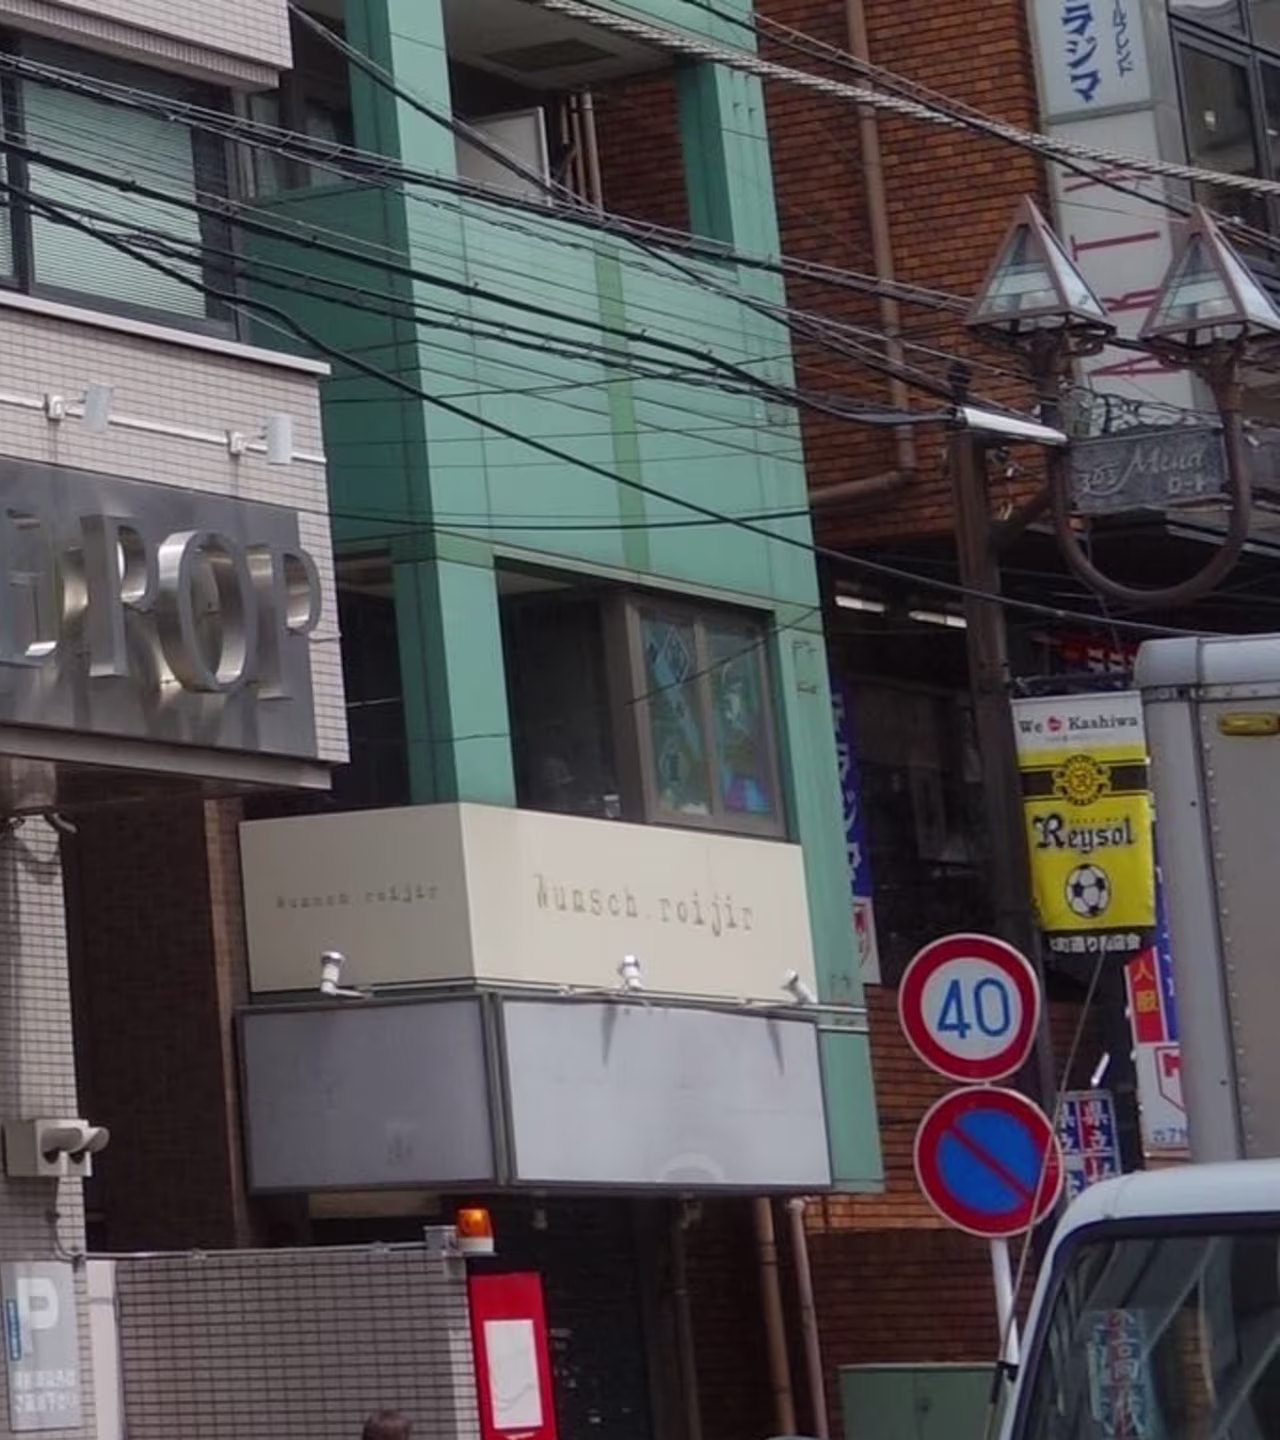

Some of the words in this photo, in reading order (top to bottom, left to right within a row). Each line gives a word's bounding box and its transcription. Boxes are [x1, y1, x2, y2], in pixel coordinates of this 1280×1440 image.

[1068, 714, 1139, 731] Kashiwa
[1032, 813, 1135, 855] Reysol
[937, 977, 1012, 1039] 40
